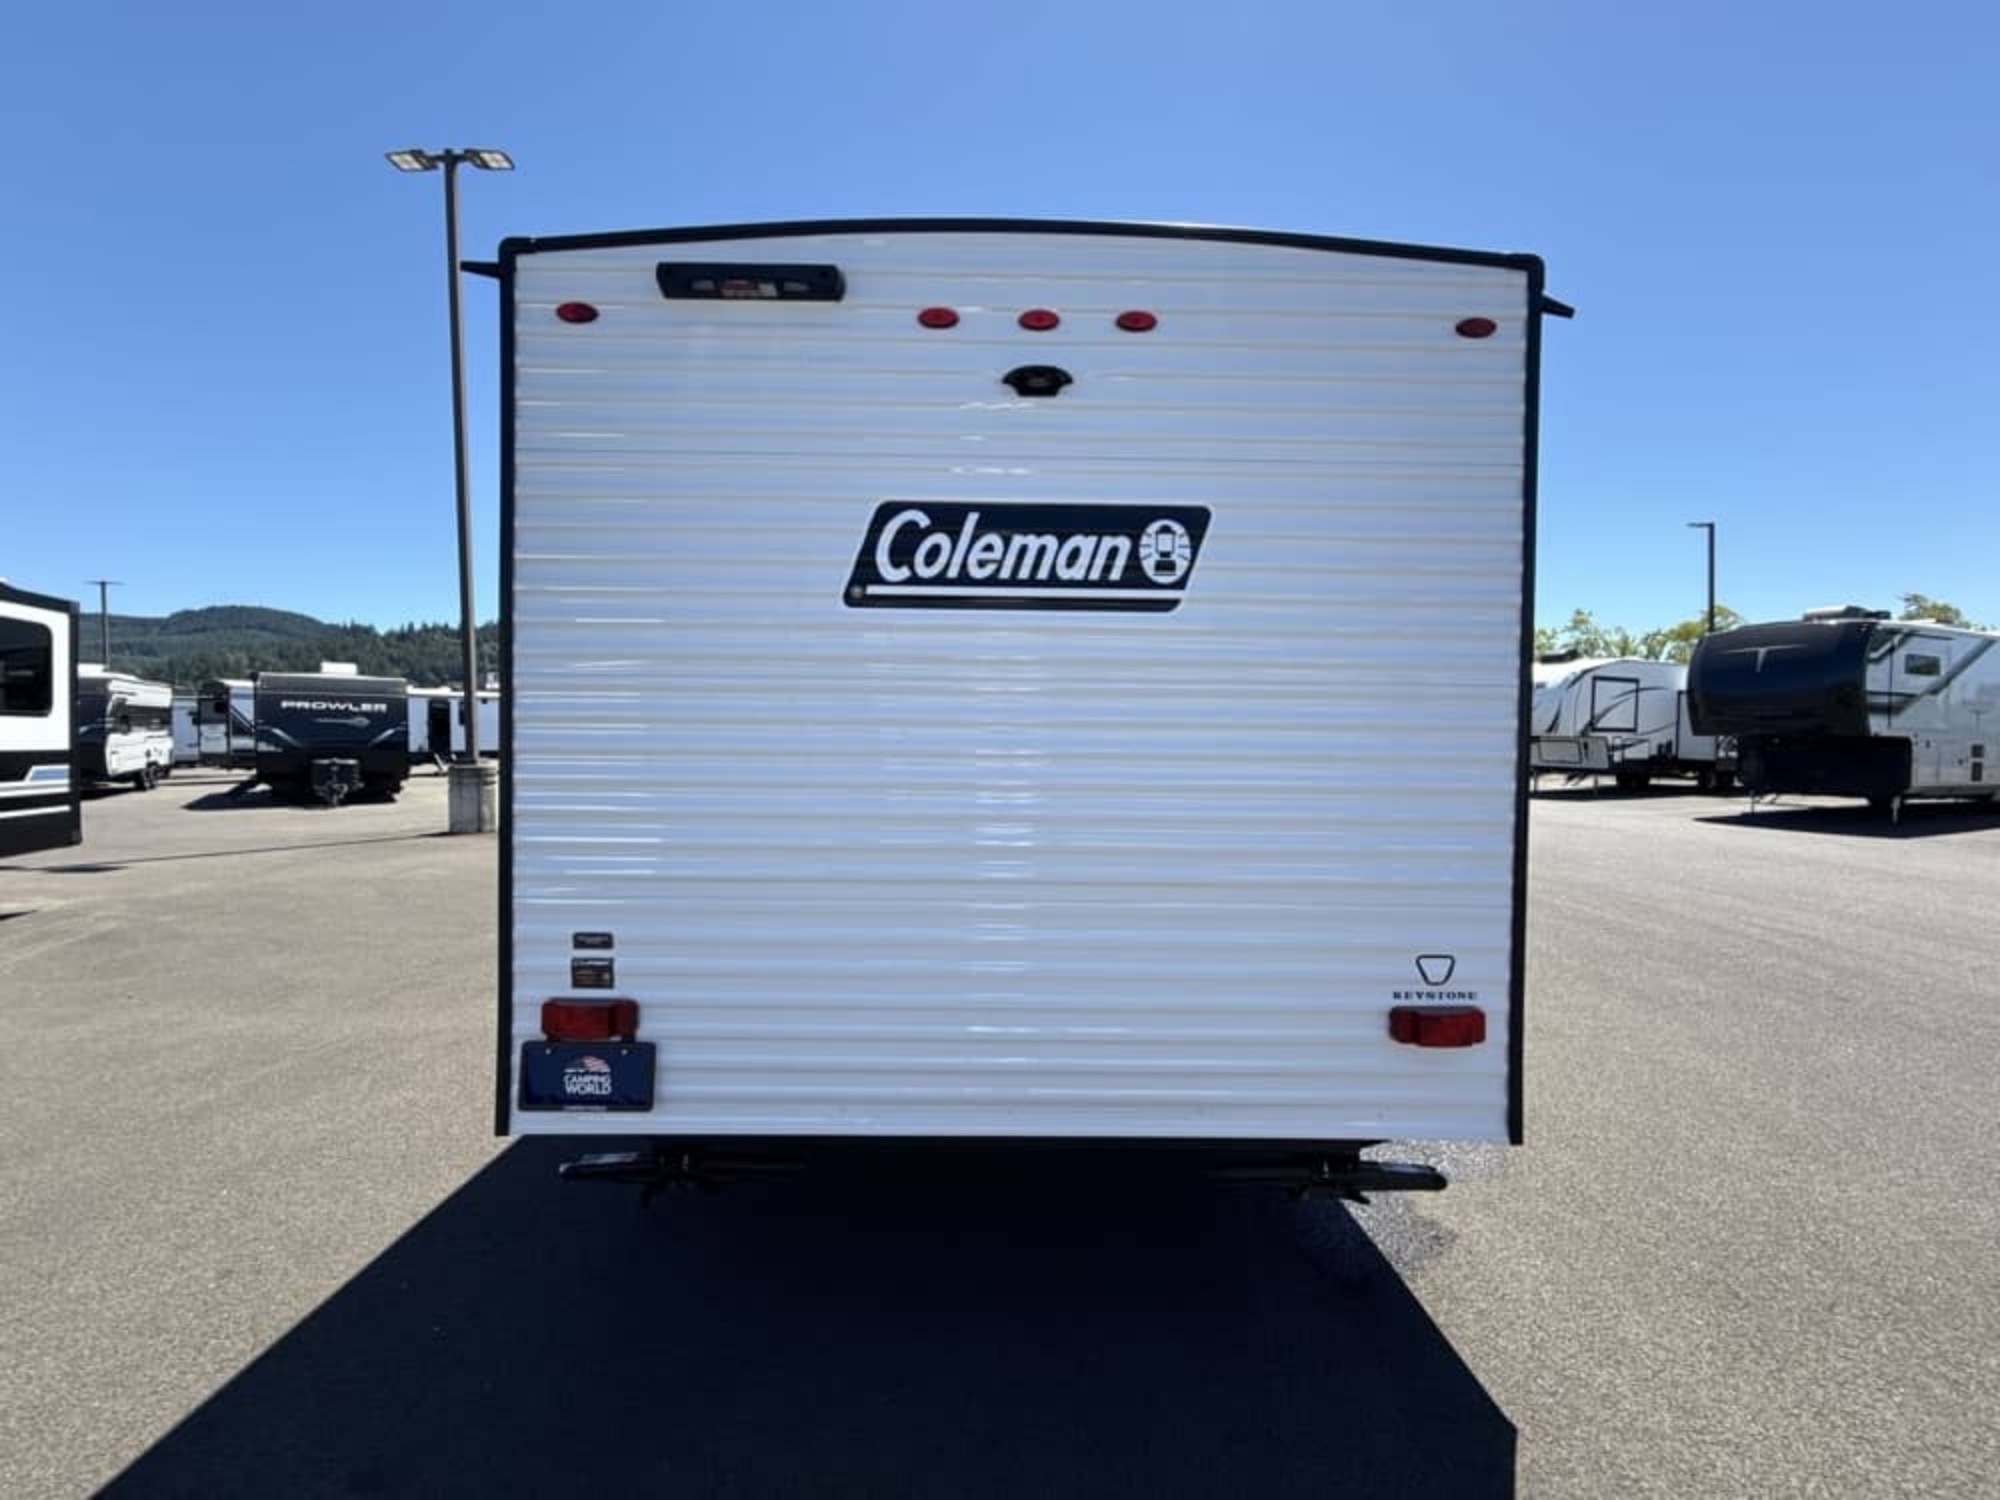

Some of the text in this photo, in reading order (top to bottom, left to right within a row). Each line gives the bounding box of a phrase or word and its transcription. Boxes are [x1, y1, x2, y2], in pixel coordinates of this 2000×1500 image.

[875, 509, 1132, 583] Coleman
[281, 700, 387, 712] PROWLER
[1392, 991, 1478, 1000] KEYSTONE
[565, 1083, 612, 1095] WORLD
